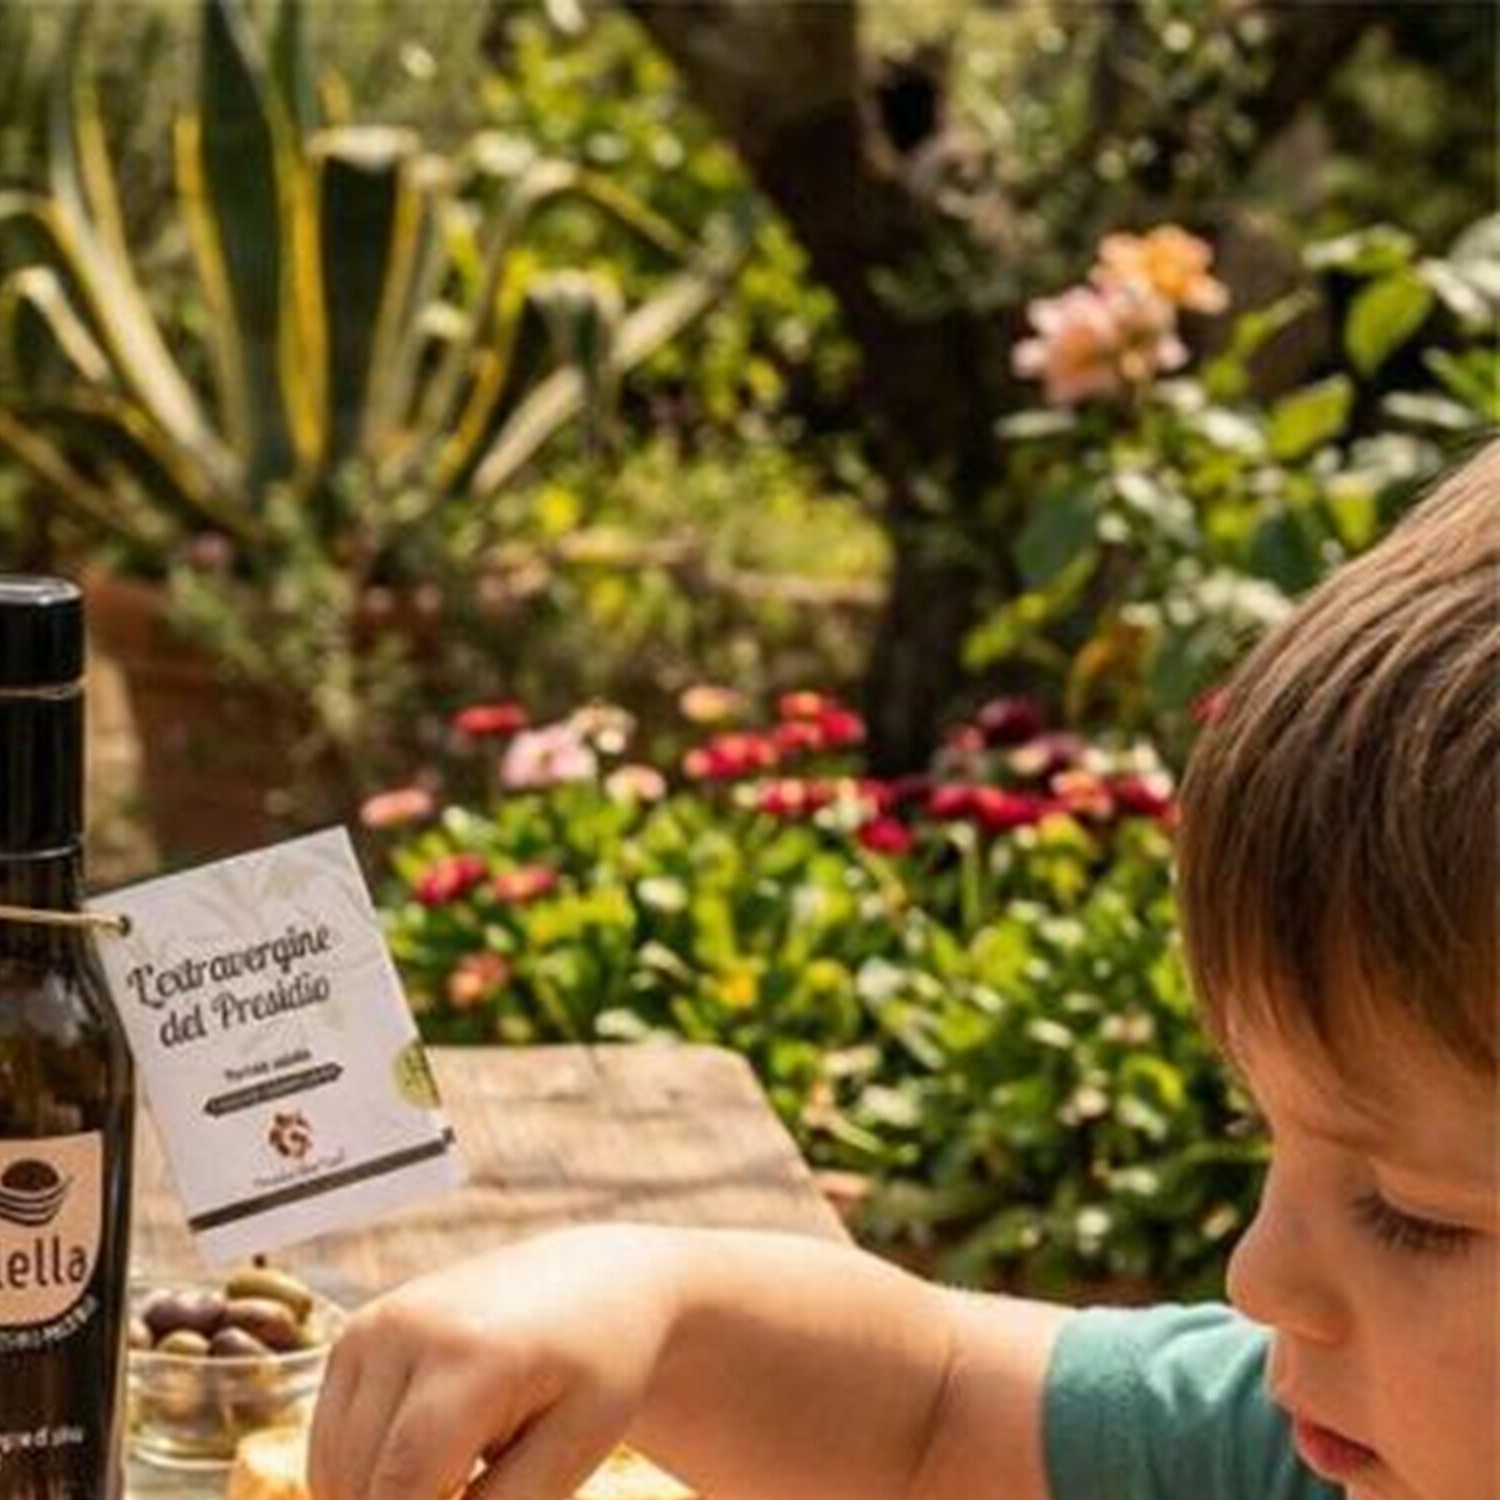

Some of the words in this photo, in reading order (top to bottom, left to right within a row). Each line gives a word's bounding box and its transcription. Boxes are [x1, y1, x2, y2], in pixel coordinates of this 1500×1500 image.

[126, 924, 333, 1010] L'extravergine
[159, 1003, 208, 1048] del
[211, 971, 330, 1030] Presidio
